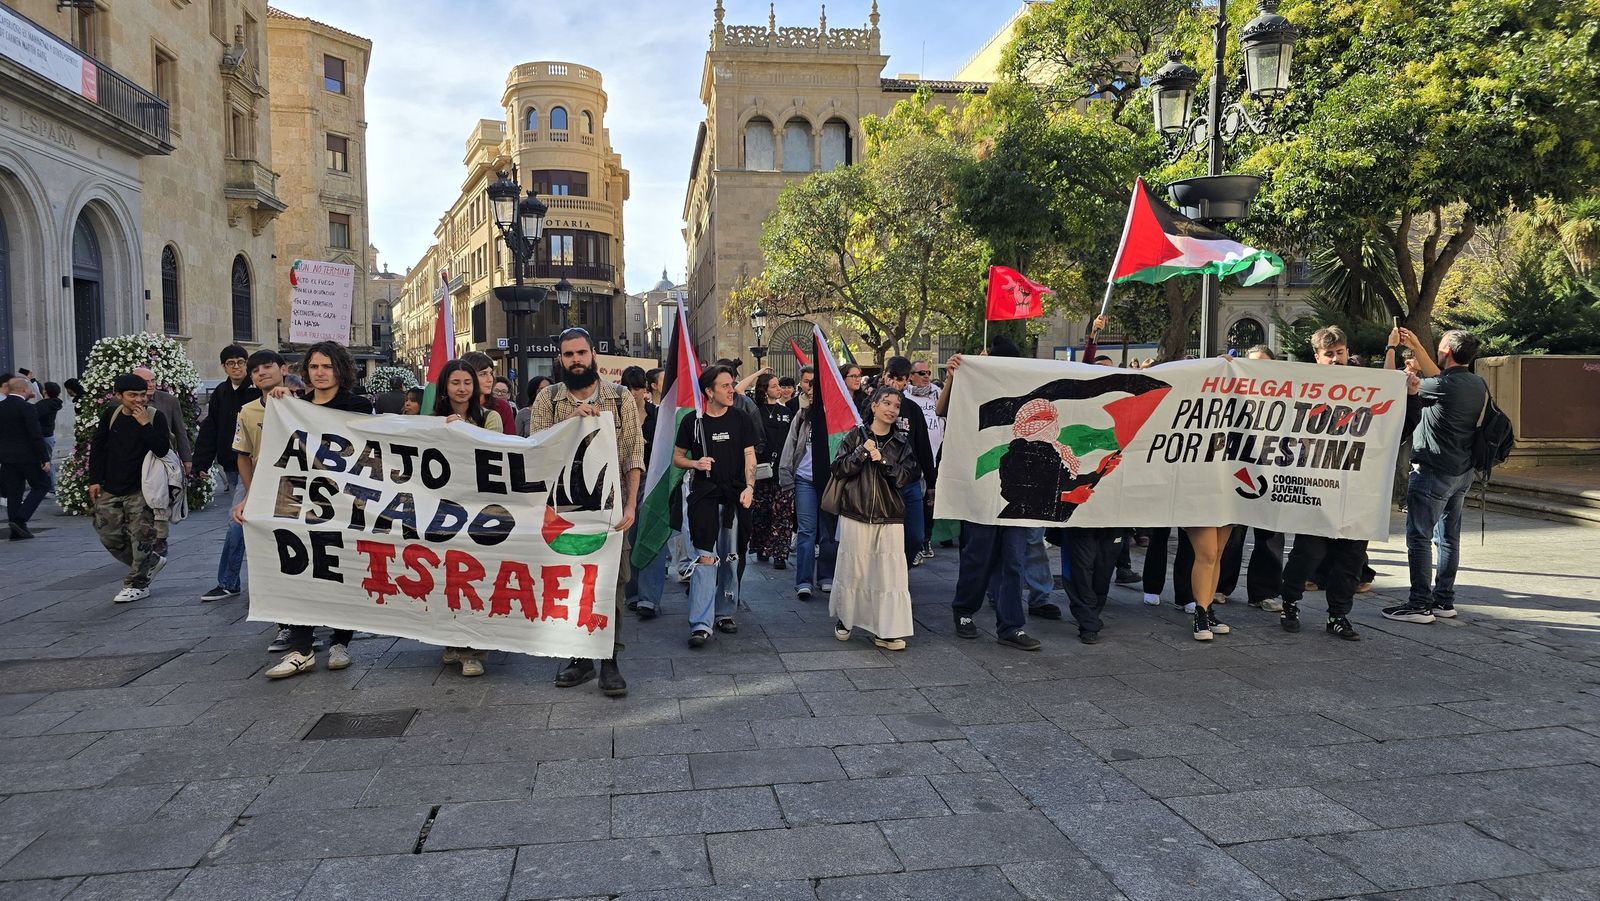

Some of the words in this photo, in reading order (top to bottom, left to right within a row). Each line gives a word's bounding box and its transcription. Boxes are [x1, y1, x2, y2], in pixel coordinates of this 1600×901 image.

[545, 219, 591, 228] OTARÍA
[1201, 377, 1293, 398] HUELGA
[1299, 382, 1325, 399] 15
[1327, 384, 1381, 403] OCT
[1171, 398, 1286, 432] PARARLO
[1291, 401, 1374, 437] TODO
[273, 429, 450, 490] ABAJO
[475, 448, 547, 495] EL
[1146, 432, 1203, 464] POR
[1204, 431, 1366, 471] PALESTINA
[1271, 484, 1308, 496] JUVENIL
[1272, 474, 1340, 489] COORDINADORA
[273, 475, 516, 546] ESTADO
[1270, 493, 1322, 507] SOCIALISTA
[272, 528, 344, 584] DE
[356, 539, 609, 635] ISRAEL
